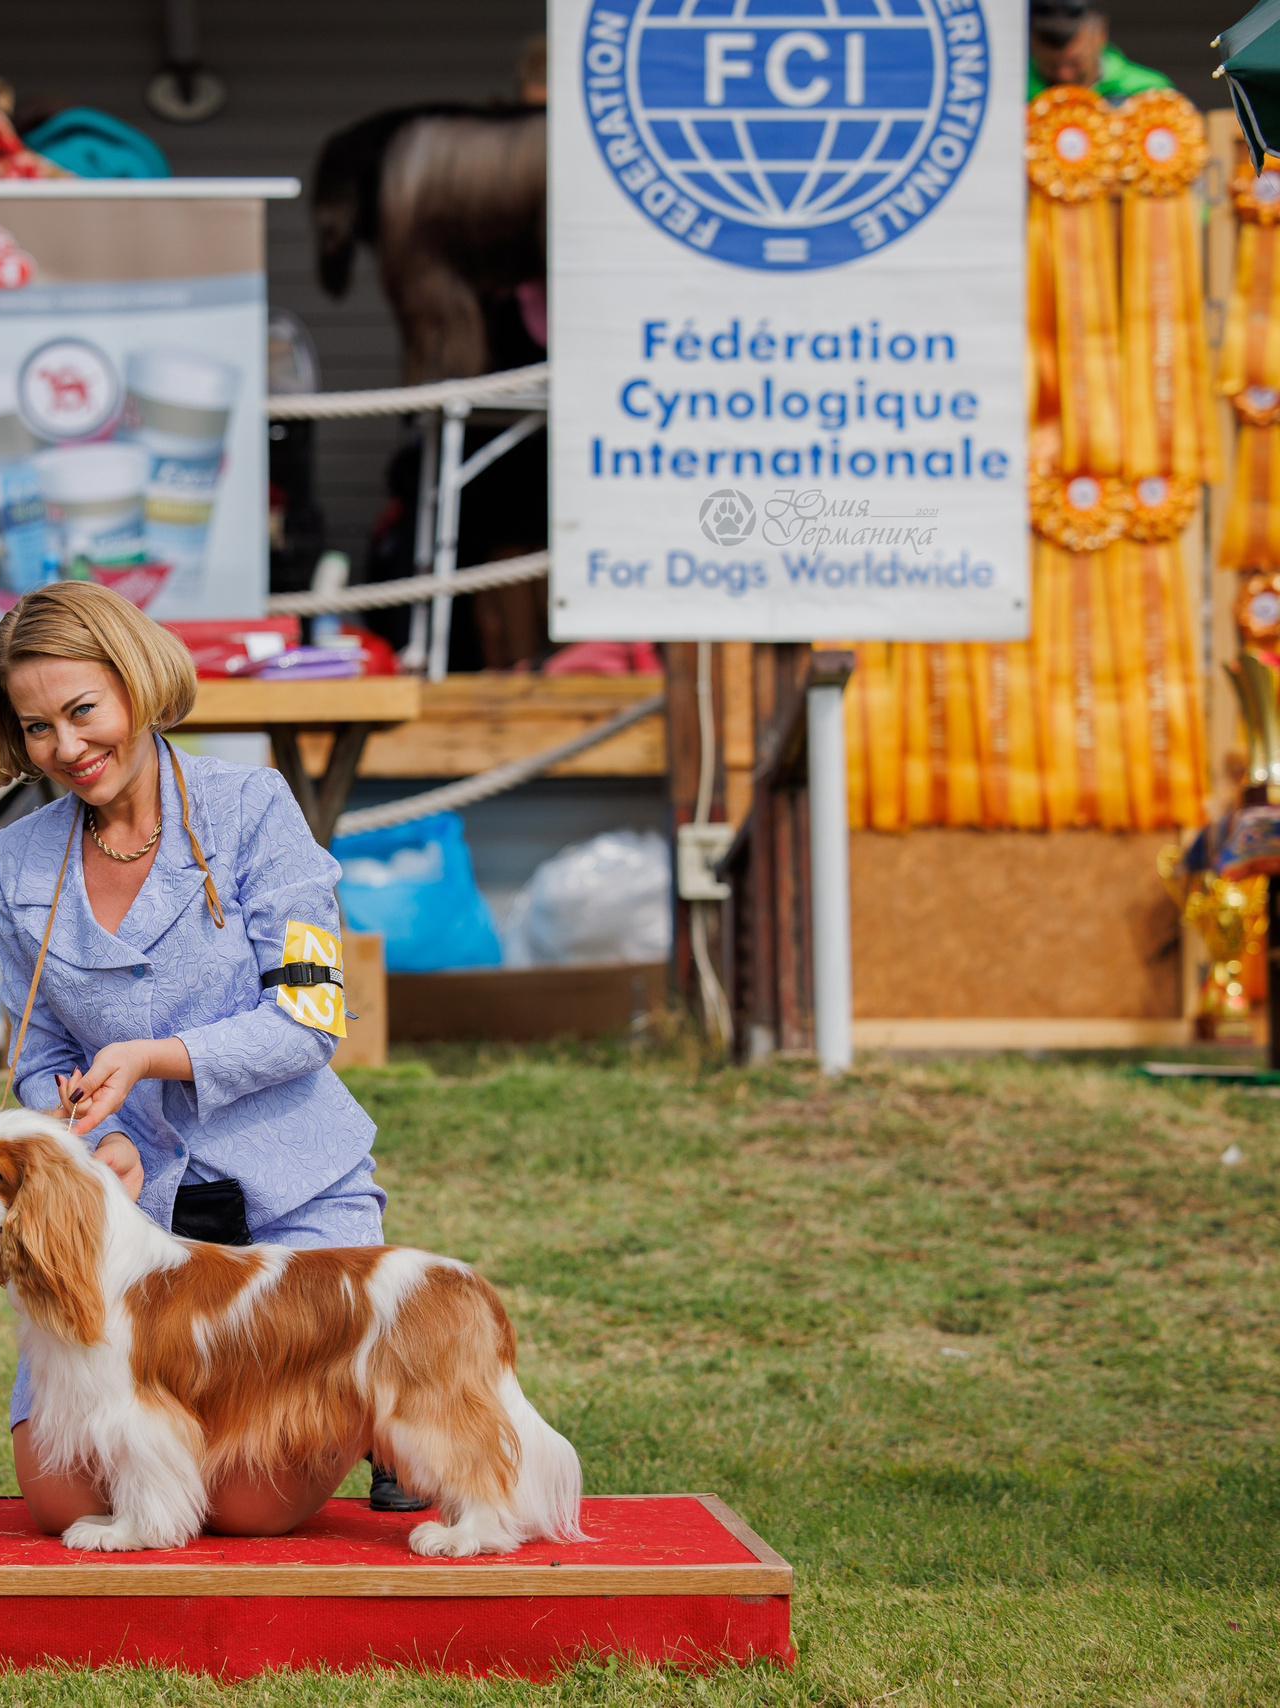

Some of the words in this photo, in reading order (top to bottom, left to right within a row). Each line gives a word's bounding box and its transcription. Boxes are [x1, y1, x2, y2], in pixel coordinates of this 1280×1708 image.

[704, 31, 866, 107] FCI
[586, 9, 722, 250] FEDERATION
[642, 319, 956, 362] Fédération
[619, 378, 980, 430] Cynologique
[590, 437, 1009, 478] Internationale
[587, 549, 652, 588] For
[666, 549, 768, 598] Dogs
[780, 549, 996, 589] Worldwide
